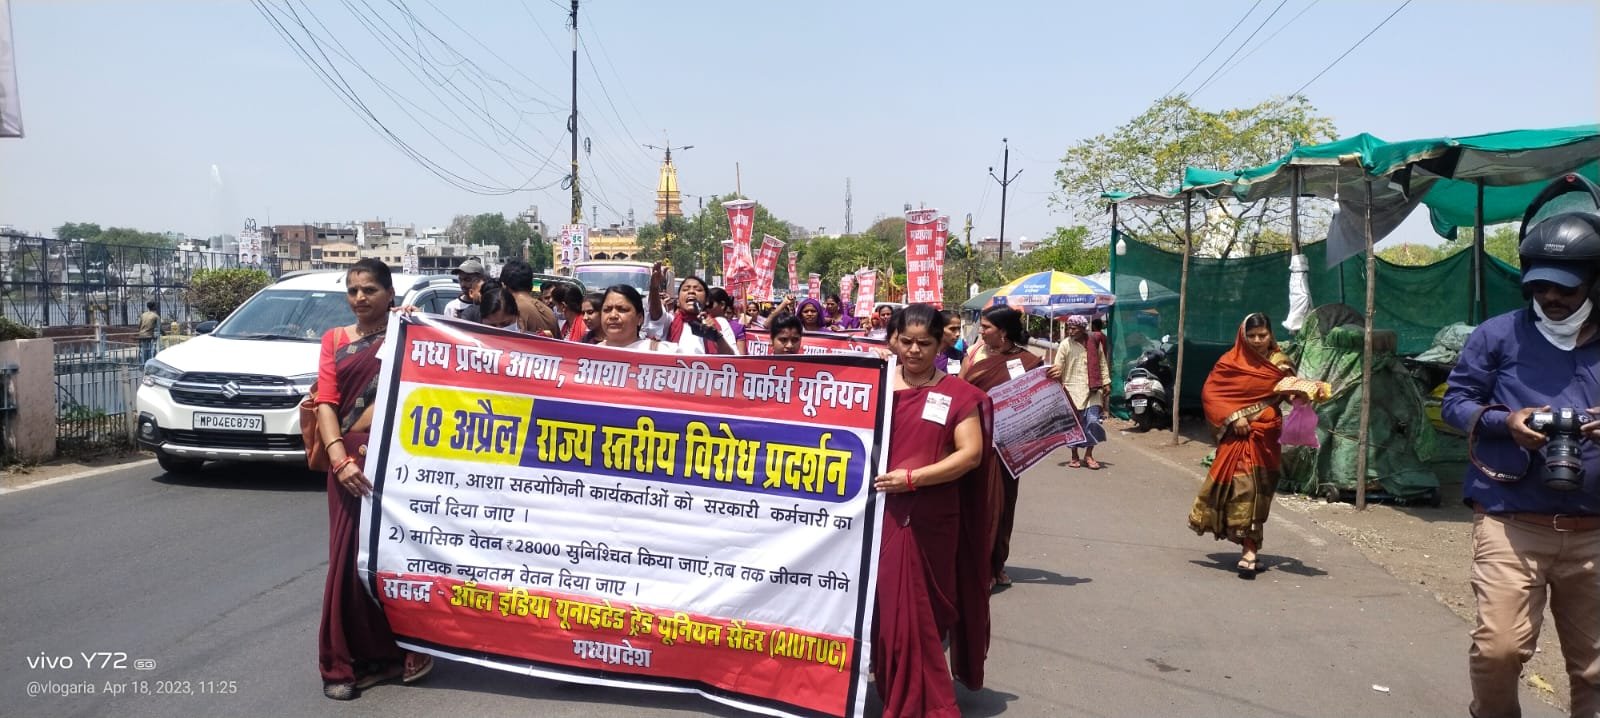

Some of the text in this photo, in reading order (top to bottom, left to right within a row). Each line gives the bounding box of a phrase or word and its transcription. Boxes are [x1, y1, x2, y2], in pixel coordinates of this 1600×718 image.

[411, 340, 450, 369] मध्य
[455, 341, 503, 374] प्रदेश
[505, 351, 565, 388] आशा,
[742, 366, 794, 404] वर्कर्स
[798, 371, 872, 417] यूनियन
[200, 415, 261, 429] MP04EC8797
[409, 399, 852, 497] 18 अप्रैल राज्य स्तरीय विरोध प्रदर्शन
[395, 465, 853, 531] 1) आशा, आशा सहयोगिनी कार्यकर्ताओं को सरकारी कर्मचारी का
[409, 494, 442, 515] दर्जा
[445, 496, 478, 519] दिया
[484, 505, 515, 523] जाए
[388, 525, 405, 544] 2)
[410, 525, 464, 548] मासिक
[469, 529, 503, 550] वेतन
[566, 540, 632, 565] सुनिश्चित
[637, 547, 674, 569] किया
[740, 566, 765, 583] तक
[769, 567, 813, 587] जीवन
[818, 570, 851, 593] जीने
[407, 558, 452, 575] लायक
[456, 565, 515, 583] न्यूनतम
[520, 564, 554, 585] वेतन
[559, 568, 591, 591] दिया
[596, 577, 626, 596] जाए
[450, 581, 494, 612] ऑल
[499, 584, 552, 619] इंडिया
[556, 598, 626, 631] यूनाइटेड
[629, 604, 654, 636] ट्रेड
[658, 612, 722, 646] यूनियन
[726, 618, 767, 653] सेंटर
[769, 629, 847, 673] (AIUTUC)
[571, 638, 653, 669] मध्यप्रदेश
